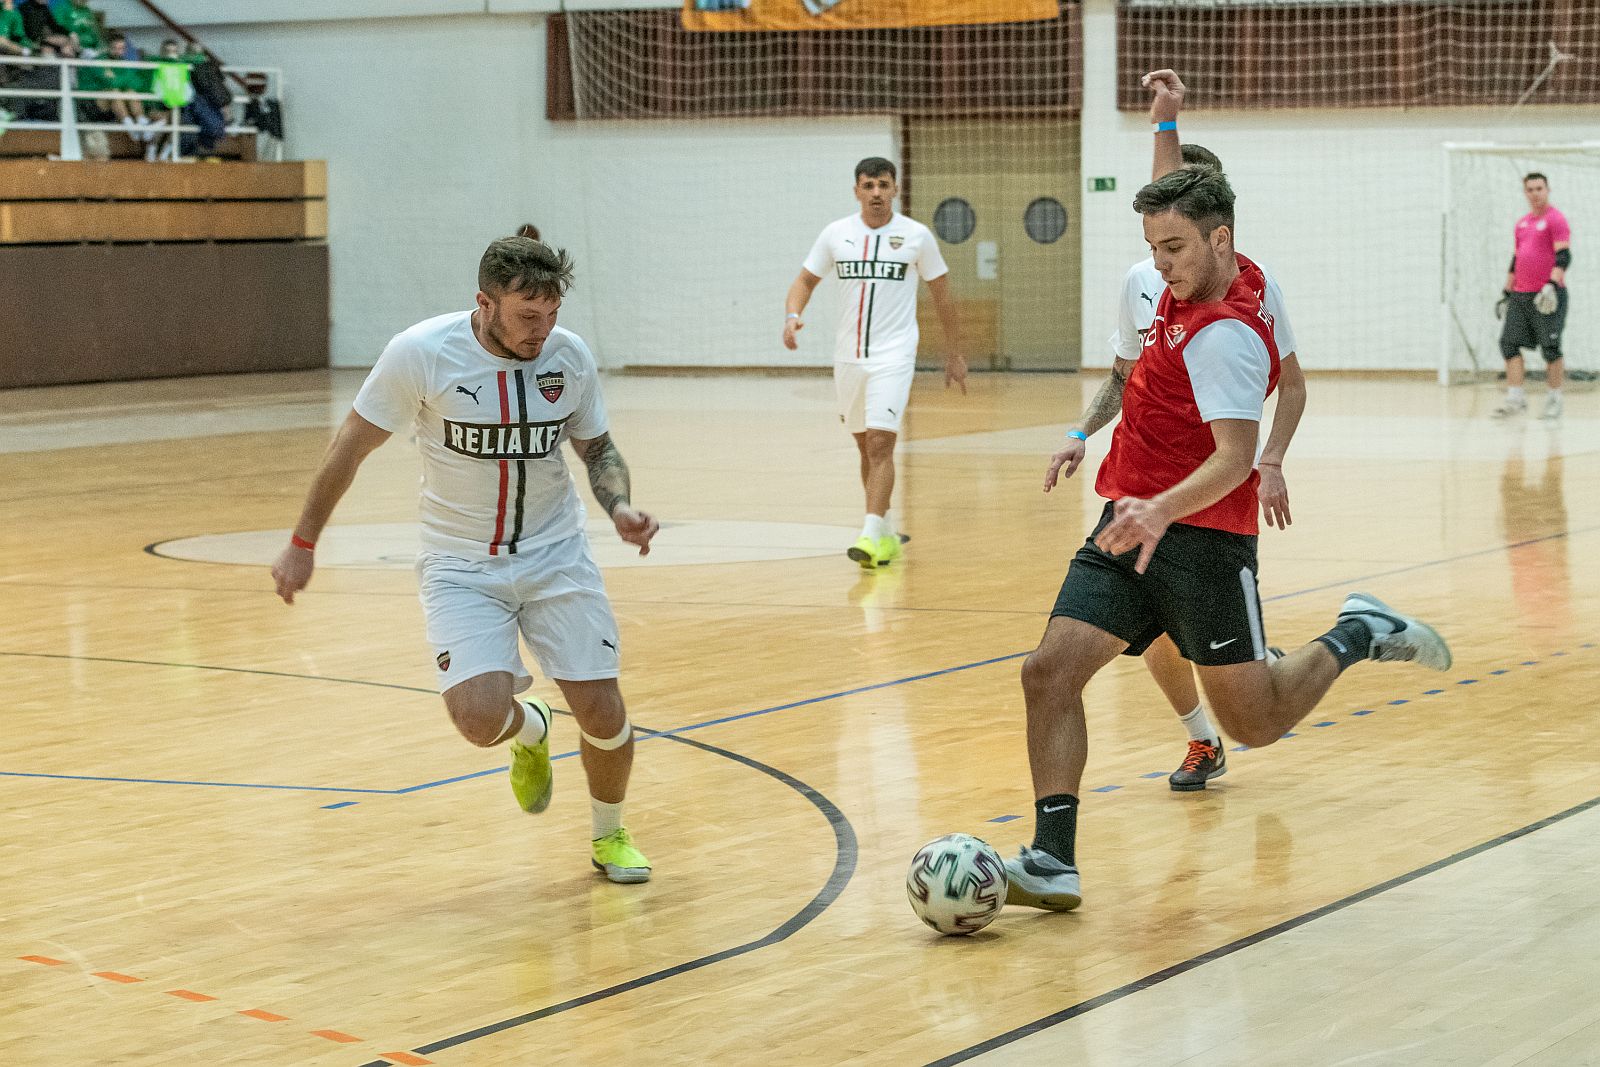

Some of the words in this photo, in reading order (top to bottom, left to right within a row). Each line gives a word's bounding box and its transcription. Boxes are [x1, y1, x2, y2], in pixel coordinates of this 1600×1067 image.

[837, 262, 872, 278] RELIA
[874, 262, 903, 278] KFT.
[450, 422, 523, 454] RELIA
